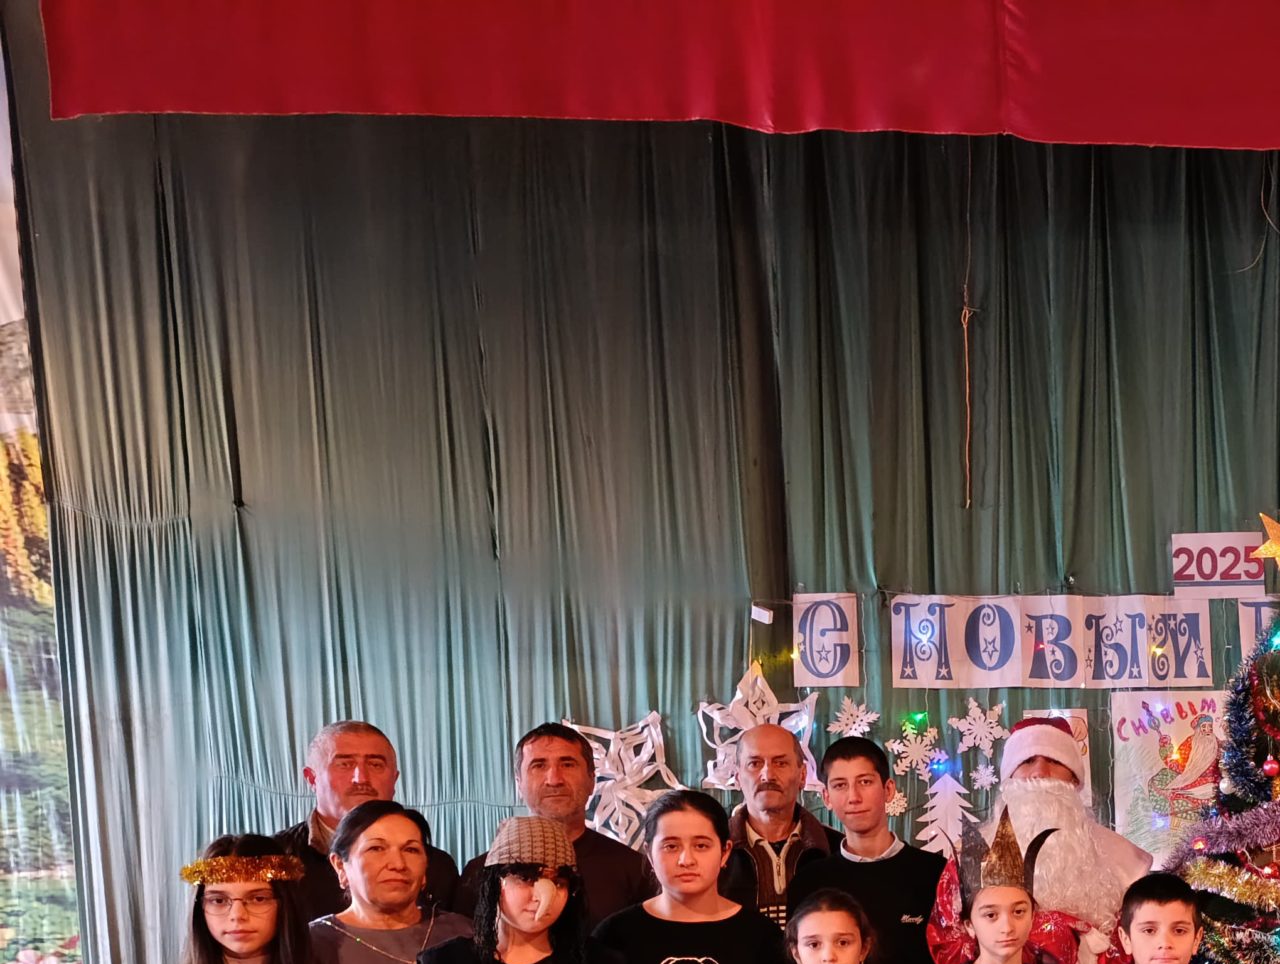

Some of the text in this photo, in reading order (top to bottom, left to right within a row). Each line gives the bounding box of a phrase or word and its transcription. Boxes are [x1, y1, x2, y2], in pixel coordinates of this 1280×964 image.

[1173, 546, 1264, 580] 2025
[799, 600, 849, 678] С
[892, 602, 1210, 680] НОВЫМ
